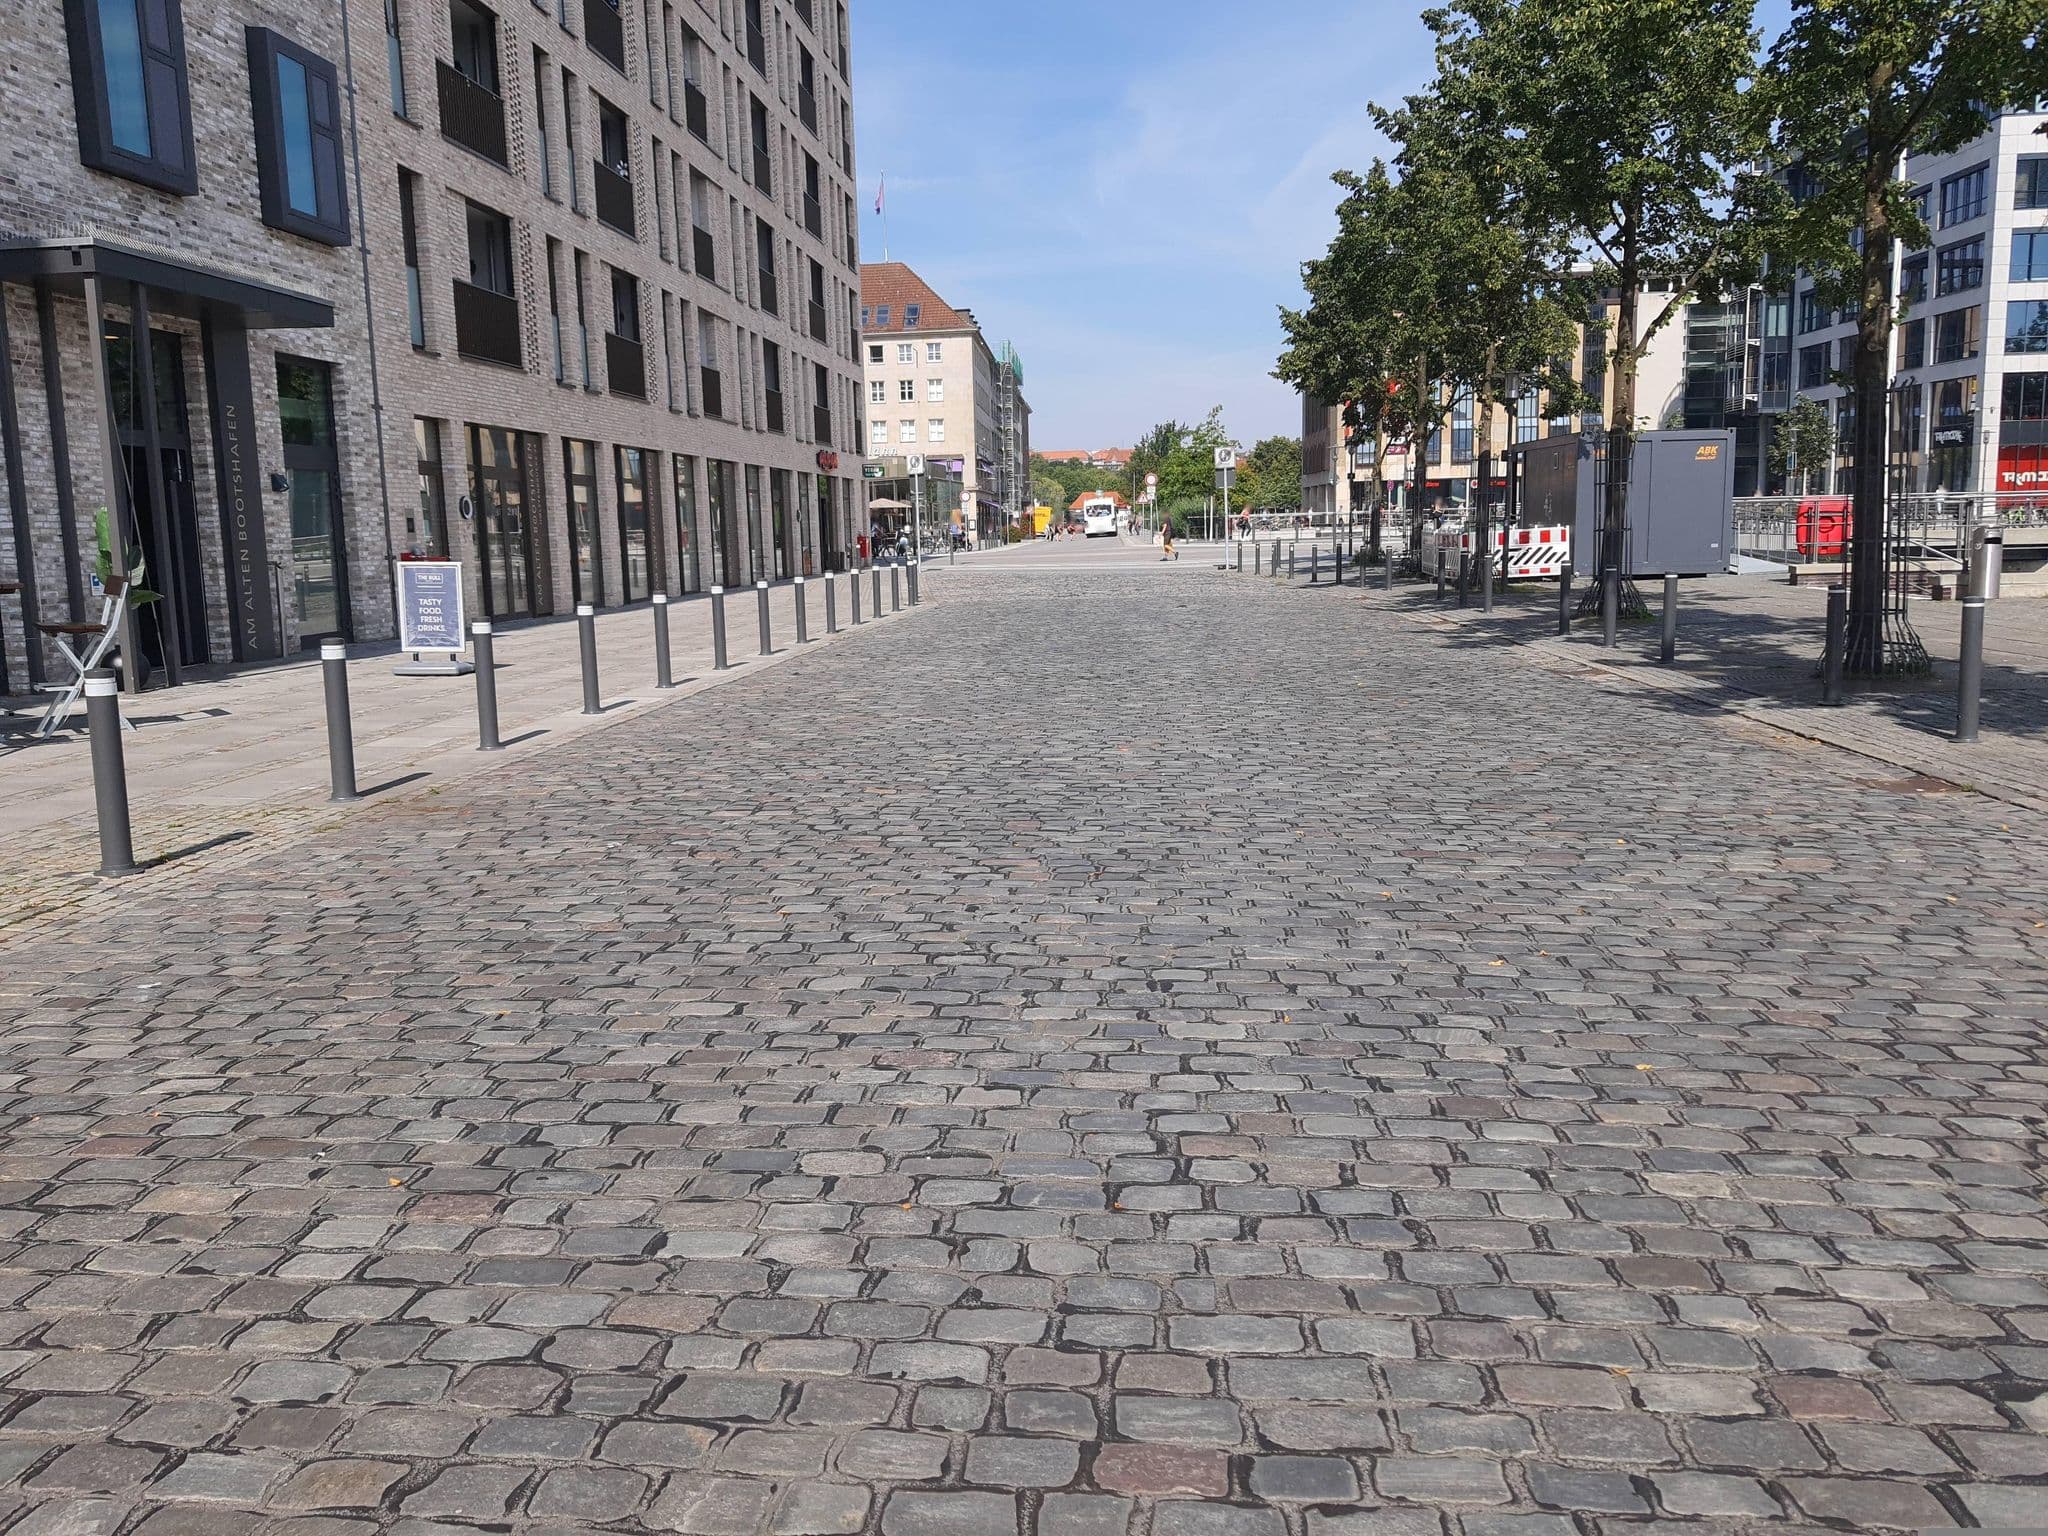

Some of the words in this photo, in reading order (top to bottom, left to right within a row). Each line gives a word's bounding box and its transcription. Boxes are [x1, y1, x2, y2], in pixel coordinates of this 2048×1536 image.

[1696, 445, 1719, 455] ABK
[226, 405, 247, 540] BOOTSHAFEN
[240, 549, 254, 610] ALTEN
[418, 598, 442, 606] TASTY
[246, 618, 257, 649] AM
